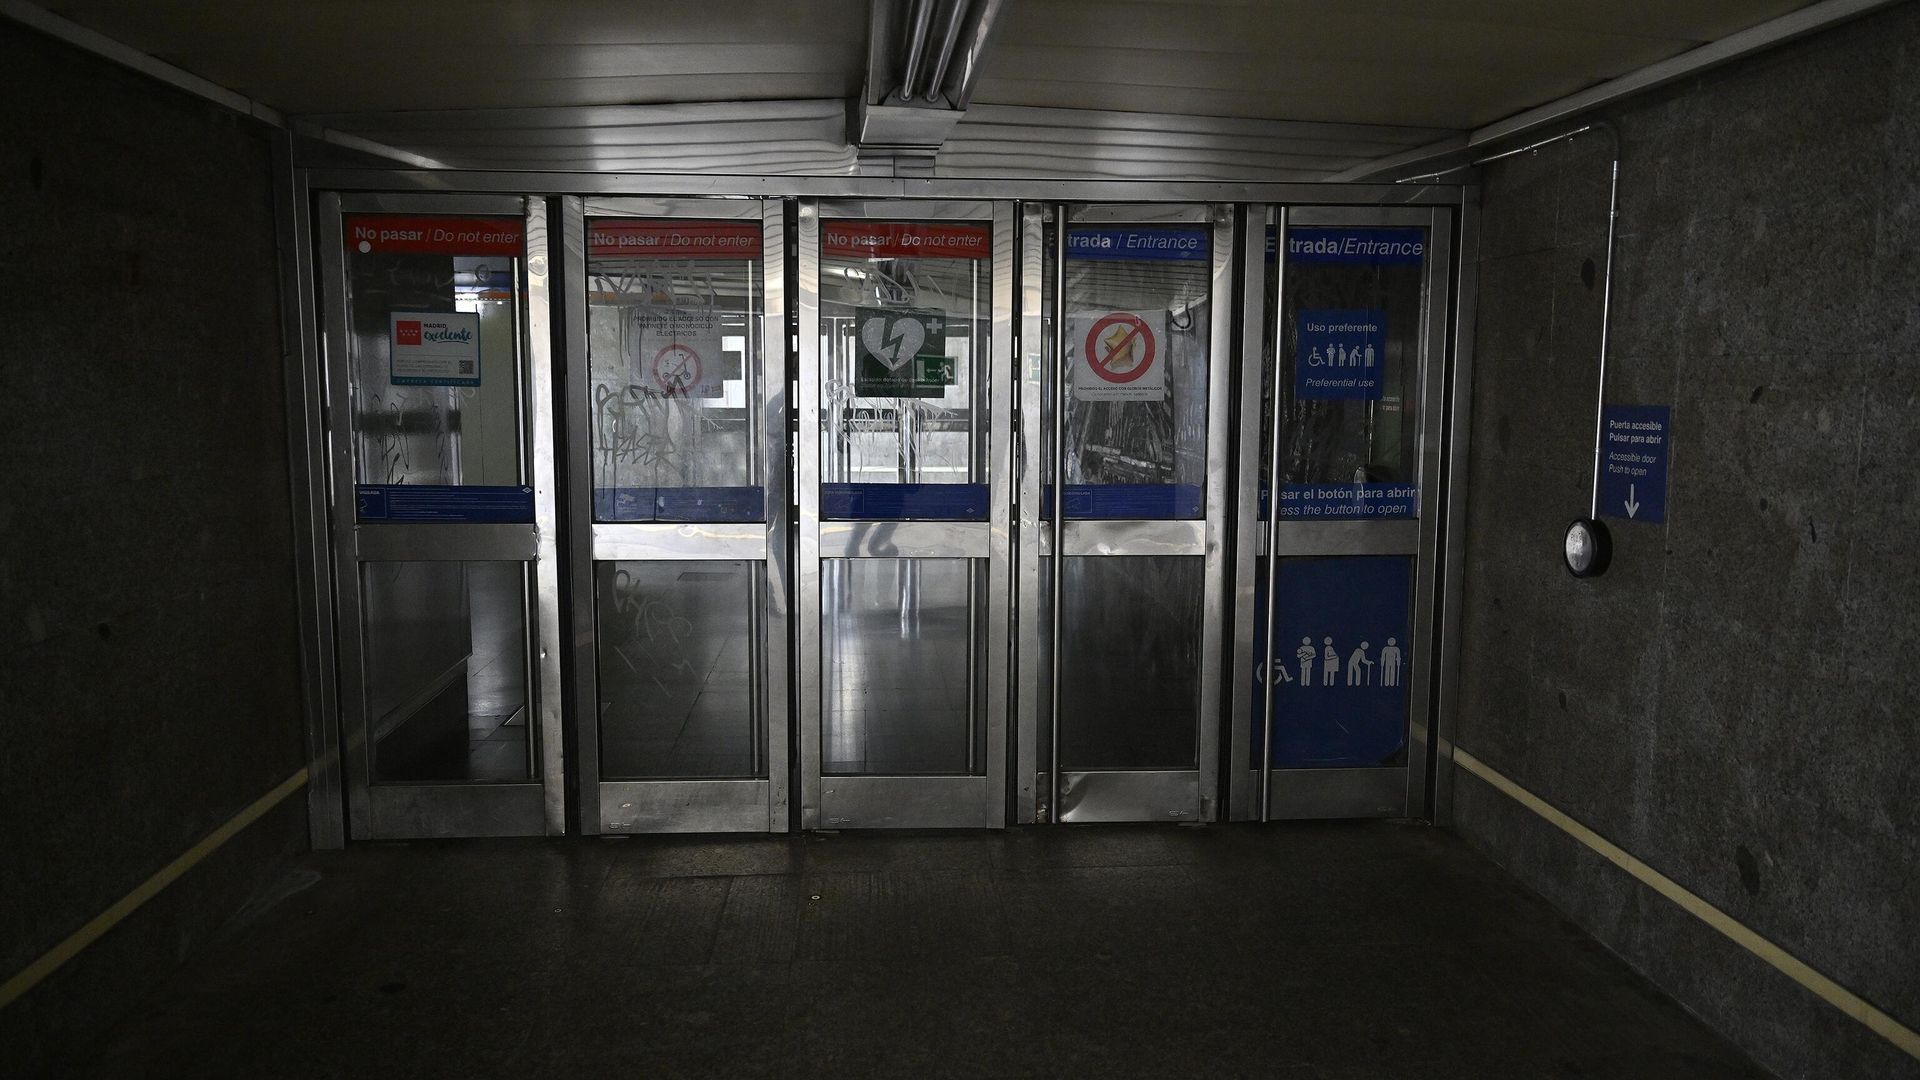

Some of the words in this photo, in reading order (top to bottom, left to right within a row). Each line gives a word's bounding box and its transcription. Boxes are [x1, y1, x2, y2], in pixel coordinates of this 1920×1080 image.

[355, 226, 377, 240] No
[380, 230, 423, 243] pasar
[433, 229, 455, 242] Do
[457, 231, 481, 243] not
[482, 232, 519, 244] enter
[594, 232, 615, 245] No
[618, 234, 659, 248] pasar
[670, 233, 690, 246] Do
[693, 234, 716, 246] not
[718, 234, 754, 247] enter
[827, 232, 848, 245] No
[851, 234, 892, 248] pasar
[901, 233, 921, 246] Do
[924, 234, 945, 246] not
[947, 234, 983, 246] enter
[1066, 233, 1111, 248] trada
[1126, 234, 1198, 249] Entrance
[1307, 322, 1326, 332] Uso
[1328, 322, 1378, 334] preferente
[1306, 378, 1357, 388] Preferential
[1359, 379, 1375, 388] use
[1609, 419, 1631, 430] Puerta
[1631, 421, 1663, 431] accesible
[1609, 432, 1630, 442] Pulsar
[1630, 435, 1645, 445] para
[1645, 434, 1662, 444] abrir
[1609, 451, 1641, 463] Accessible
[1641, 454, 1657, 464] door
[1609, 463, 1624, 474] Push
[1624, 466, 1630, 475] to
[1630, 467, 1647, 477] open
[1303, 488, 1314, 500] el
[1318, 487, 1353, 499] botón
[1356, 487, 1383, 501] para
[1386, 487, 1416, 498] abrir
[1303, 504, 1321, 515] the
[1324, 503, 1360, 515] button
[1363, 503, 1375, 514] to
[1378, 504, 1407, 517] open
